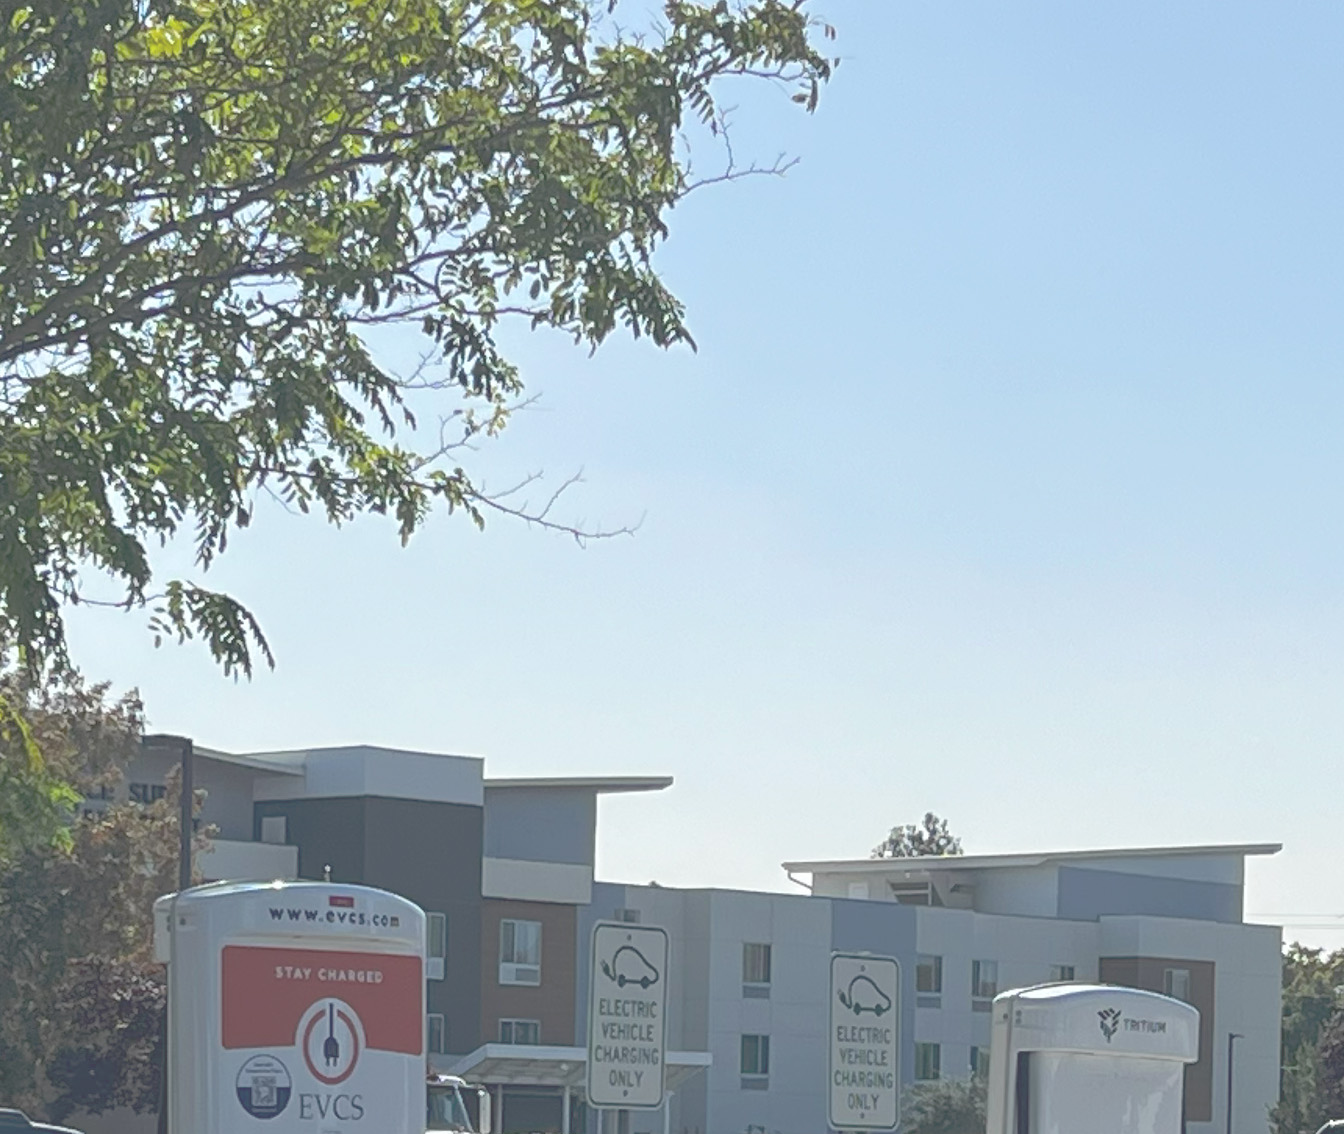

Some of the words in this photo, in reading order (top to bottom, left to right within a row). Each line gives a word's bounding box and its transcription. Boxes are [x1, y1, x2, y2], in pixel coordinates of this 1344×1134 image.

[269, 907, 400, 928] www.evcs.com
[275, 966, 312, 980] STAY
[317, 967, 384, 984] CHARGED
[598, 997, 658, 1019] ELECTRIC
[601, 1022, 655, 1042] VEHICLE
[836, 1025, 892, 1044] ELECTRIC
[1124, 1019, 1166, 1033] TRITIUM
[594, 1044, 660, 1066] CHARGING
[839, 1048, 889, 1066] VEHICLE
[609, 1069, 644, 1088] ONLY
[833, 1069, 894, 1090] CHARGING
[298, 1093, 365, 1121] EVCS
[847, 1094, 880, 1112] ONLY
